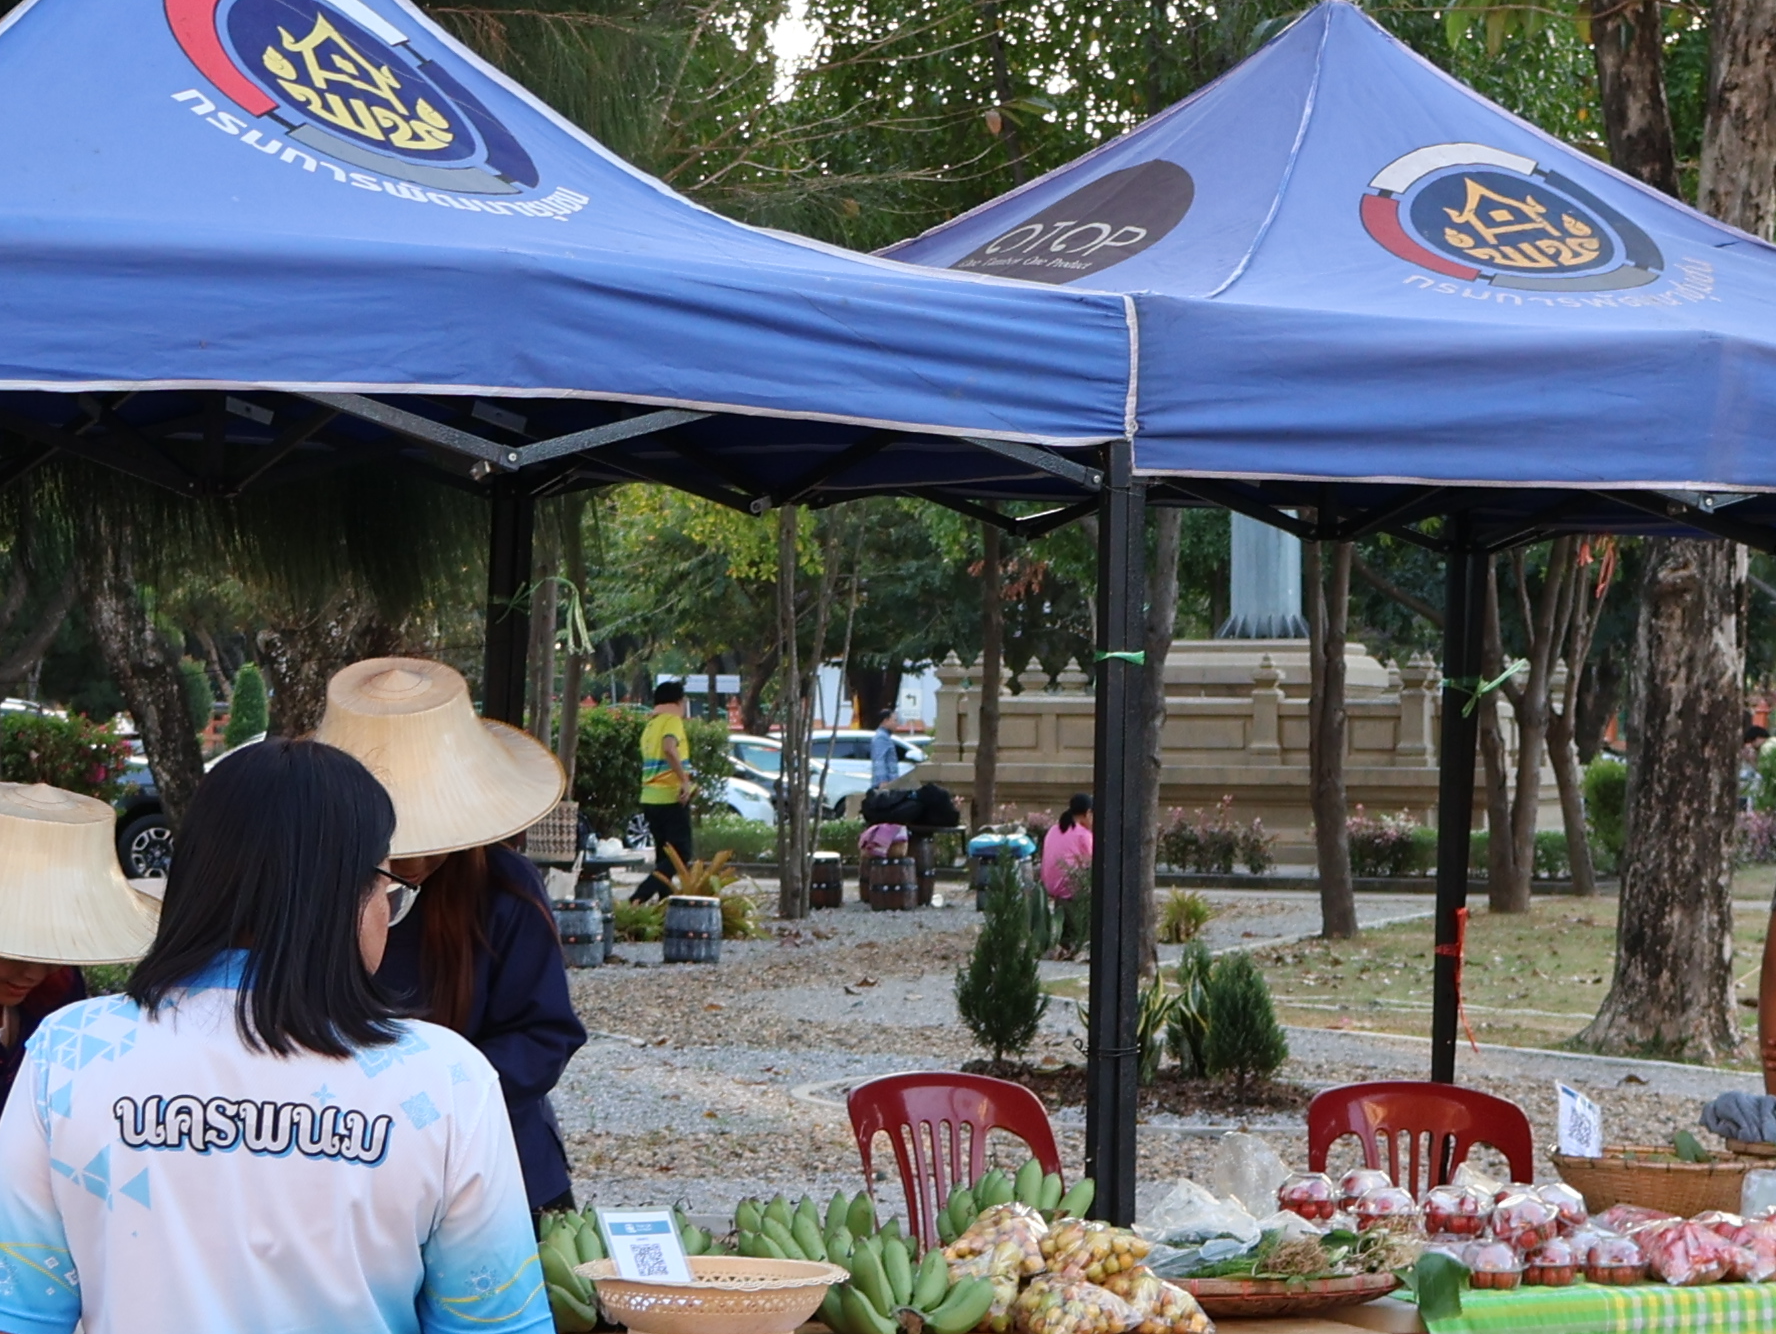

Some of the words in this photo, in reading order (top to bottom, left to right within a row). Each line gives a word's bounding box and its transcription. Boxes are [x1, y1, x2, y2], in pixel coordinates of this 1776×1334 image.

[985, 221, 1147, 257] OTOP
[113, 1094, 392, 1166] นครพนม
